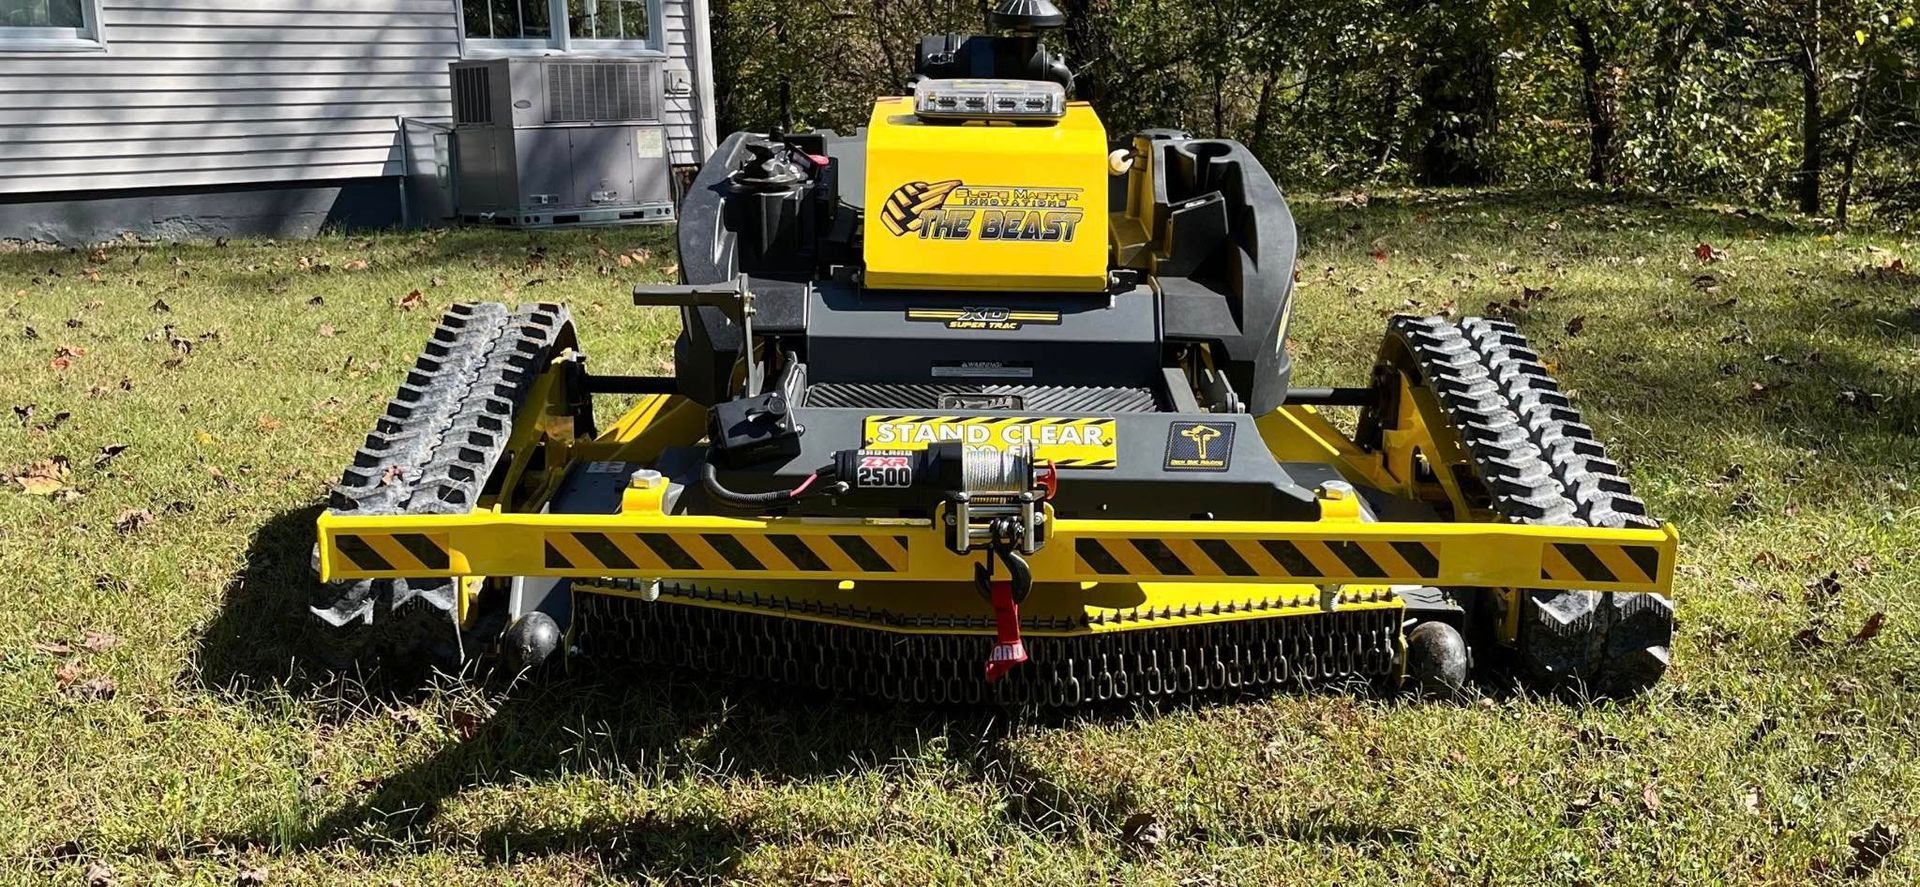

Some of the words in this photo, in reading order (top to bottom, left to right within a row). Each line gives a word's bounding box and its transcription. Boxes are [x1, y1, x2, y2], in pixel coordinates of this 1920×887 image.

[963, 198, 1068, 208] INNOVATIONS
[919, 209, 975, 240] THE
[979, 210, 1083, 242] BEAST
[877, 423, 990, 443] STAND
[1001, 424, 1104, 445] CLEAR
[862, 456, 908, 468] ZXR
[858, 468, 912, 487] 2500
